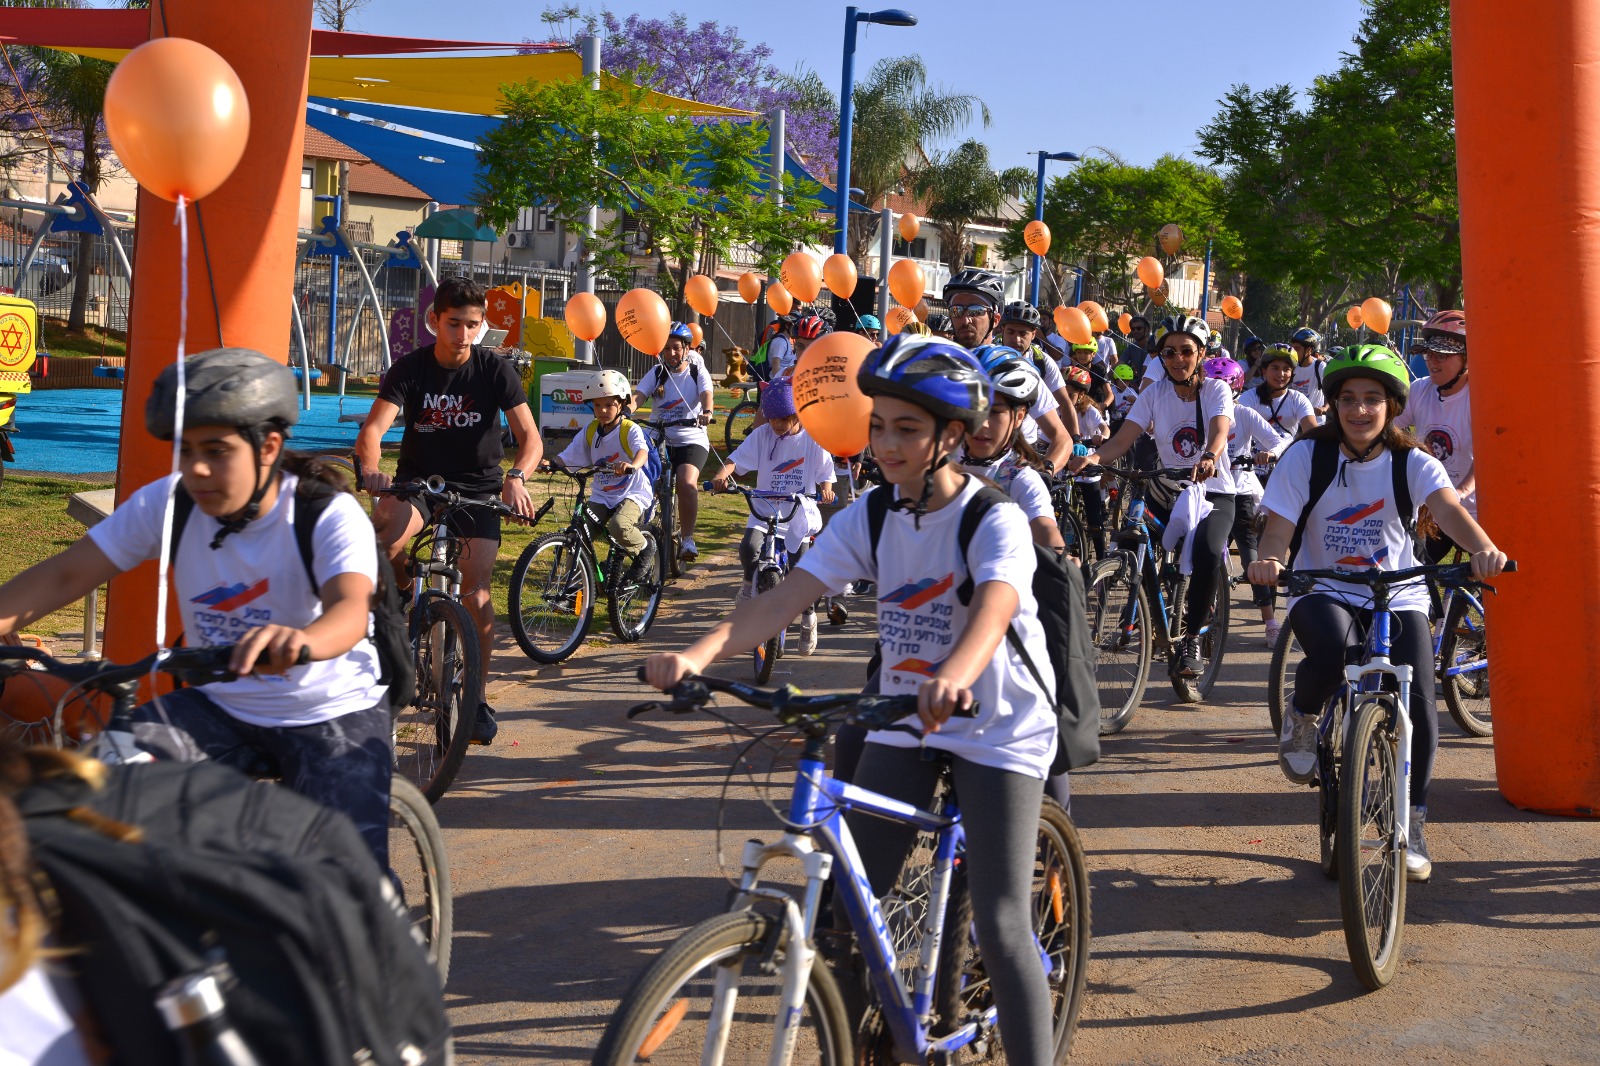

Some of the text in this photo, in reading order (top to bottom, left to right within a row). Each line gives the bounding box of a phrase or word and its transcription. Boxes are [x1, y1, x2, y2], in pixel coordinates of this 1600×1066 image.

[831, 373, 846, 382] של
[553, 391, 584, 401] פריגת
[423, 393, 463, 411] NON
[1363, 519, 1383, 527] מסע
[1327, 525, 1381, 536] אופניים לזכרו
[1351, 537, 1366, 545] רועי
[1368, 537, 1380, 545] של
[1340, 546, 1356, 554] סדן
[897, 642, 921, 655] סדן
